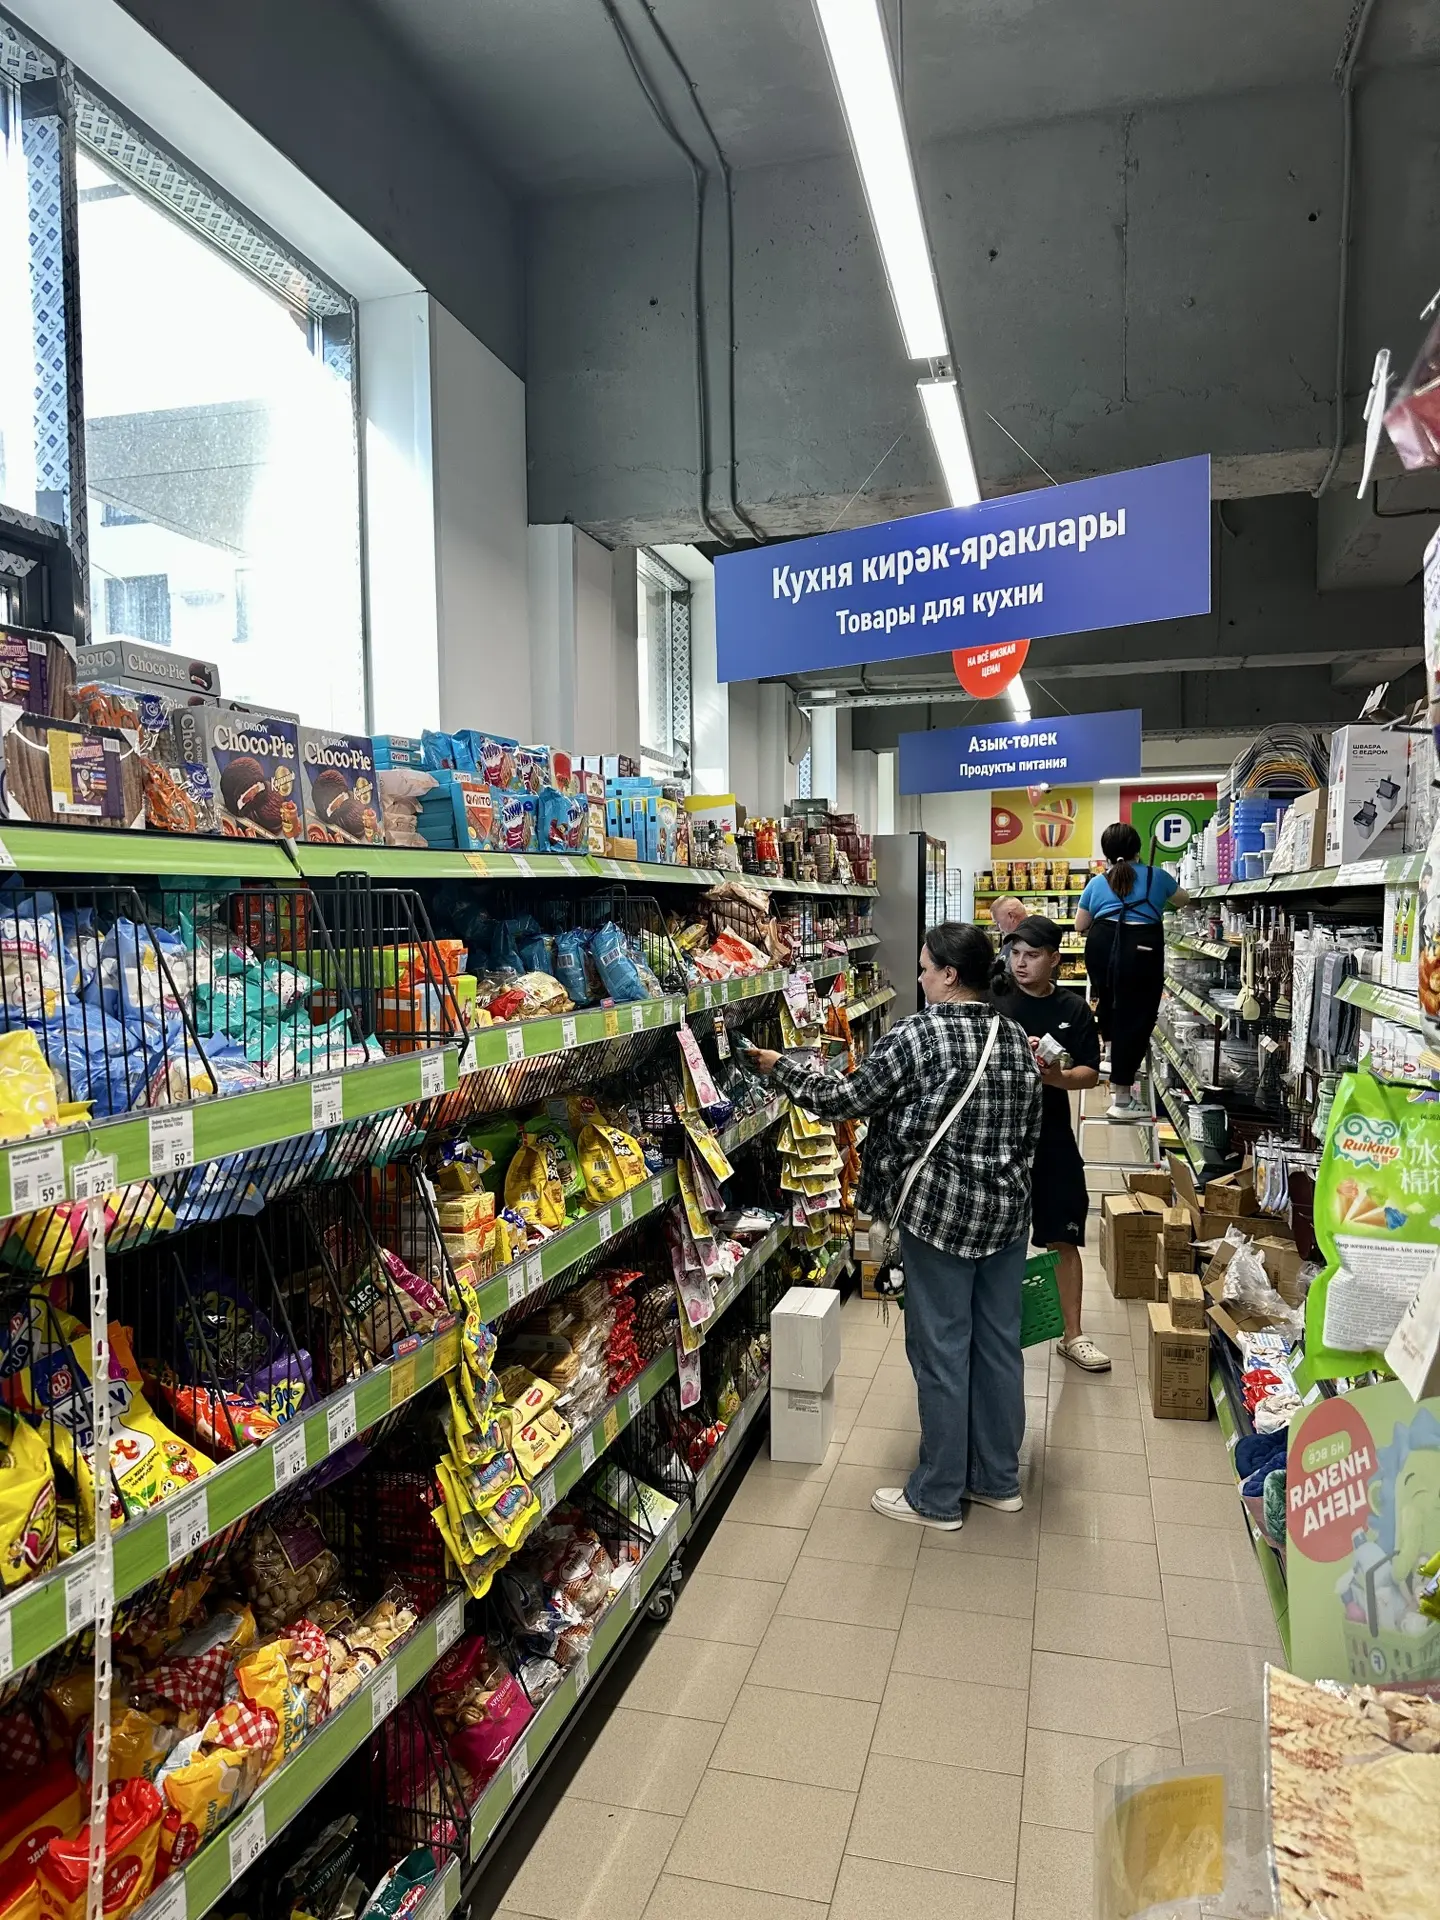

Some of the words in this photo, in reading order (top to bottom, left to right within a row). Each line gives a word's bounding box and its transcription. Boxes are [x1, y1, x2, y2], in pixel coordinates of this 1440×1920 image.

[772, 561, 854, 604] Кухня
[861, 507, 1127, 585] кирәк-яраклары
[836, 602, 916, 635] Товары
[922, 597, 965, 625] для
[972, 580, 1045, 618] кухни
[967, 657, 977, 668] НА
[977, 650, 990, 665] ВСЁ
[990, 643, 1016, 661] НИЗКАЯ
[981, 662, 1001, 678] ЦЕНА!
[968, 730, 1058, 753] Азык-төлек
[959, 761, 1016, 777] Продукты
[1018, 757, 1068, 772] питания
[329, 1112, 337, 1123] 31
[174, 1153, 185, 1166] 59
[42, 1187, 55, 1202] 59
[95, 1181, 106, 1194] 22
[292, 1460, 301, 1474] 62
[190, 1529, 202, 1546] 69
